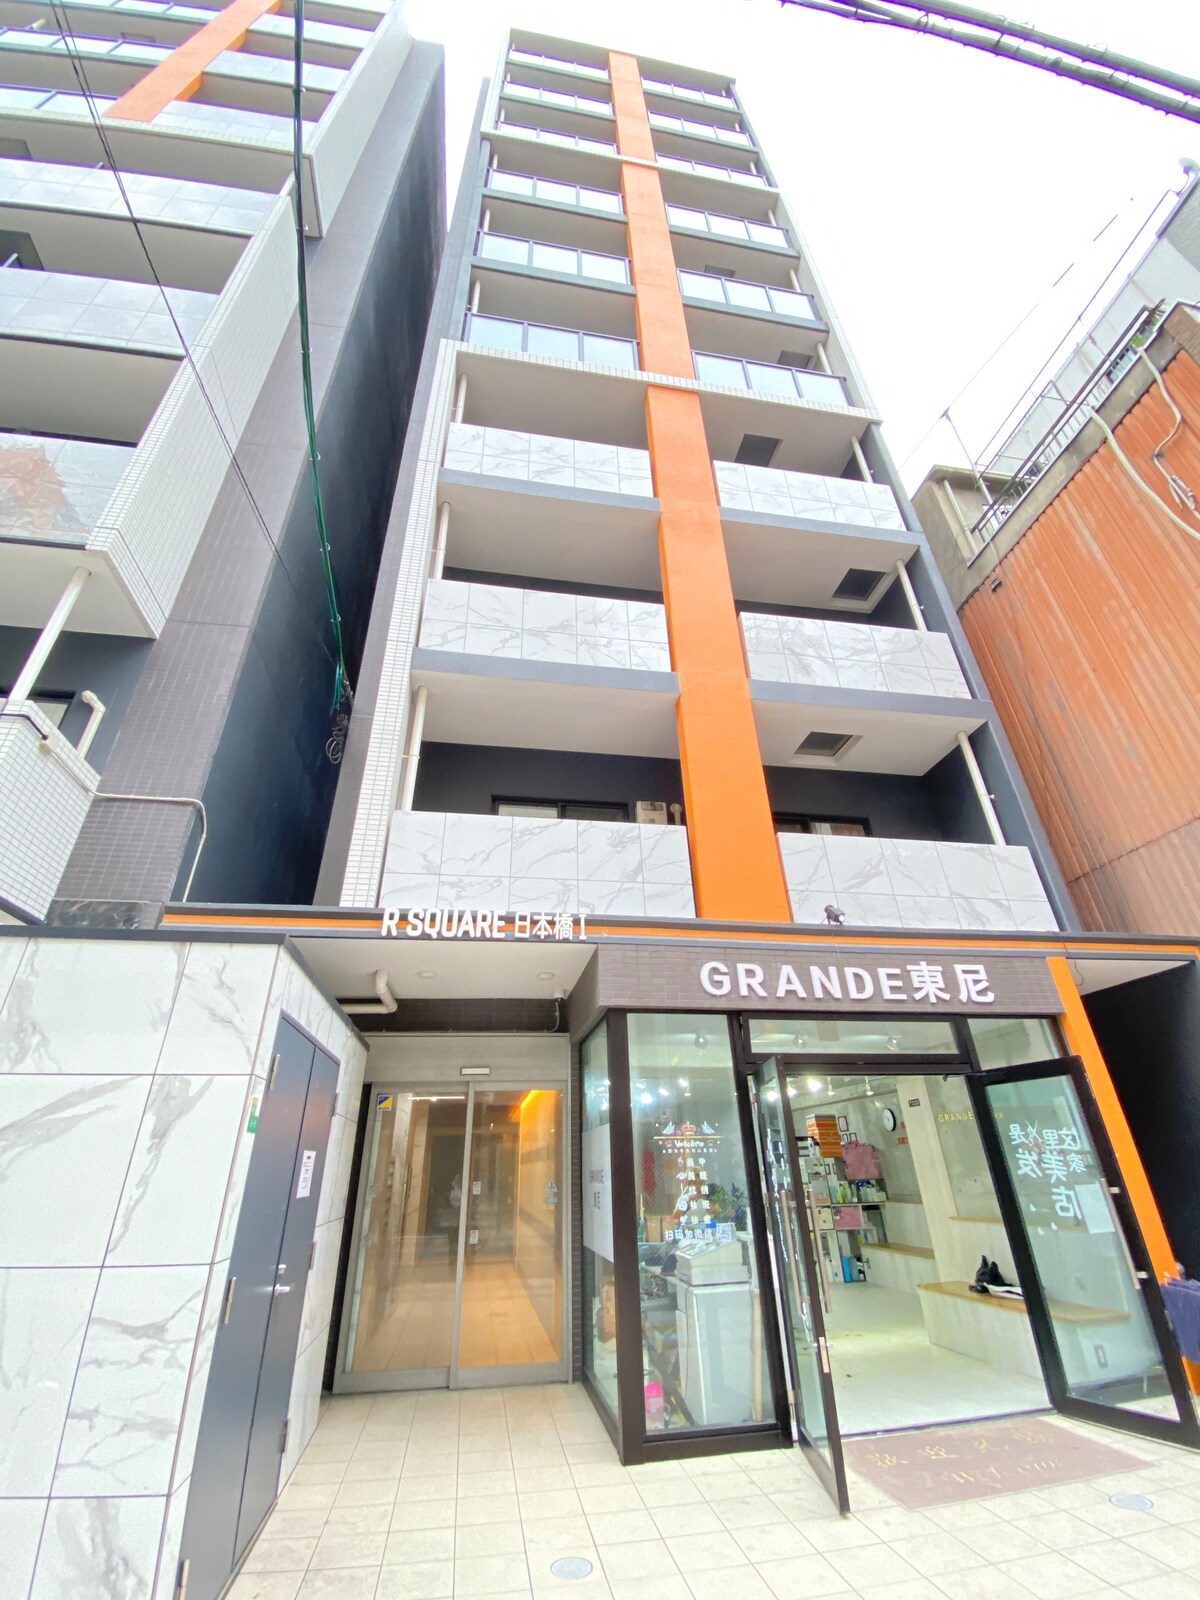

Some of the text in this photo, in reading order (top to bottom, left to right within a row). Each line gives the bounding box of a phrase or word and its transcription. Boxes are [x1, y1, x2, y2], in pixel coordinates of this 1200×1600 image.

[381, 907, 400, 937] R
[406, 907, 507, 939] SQUARE
[938, 1111, 974, 1123] GRANDE
